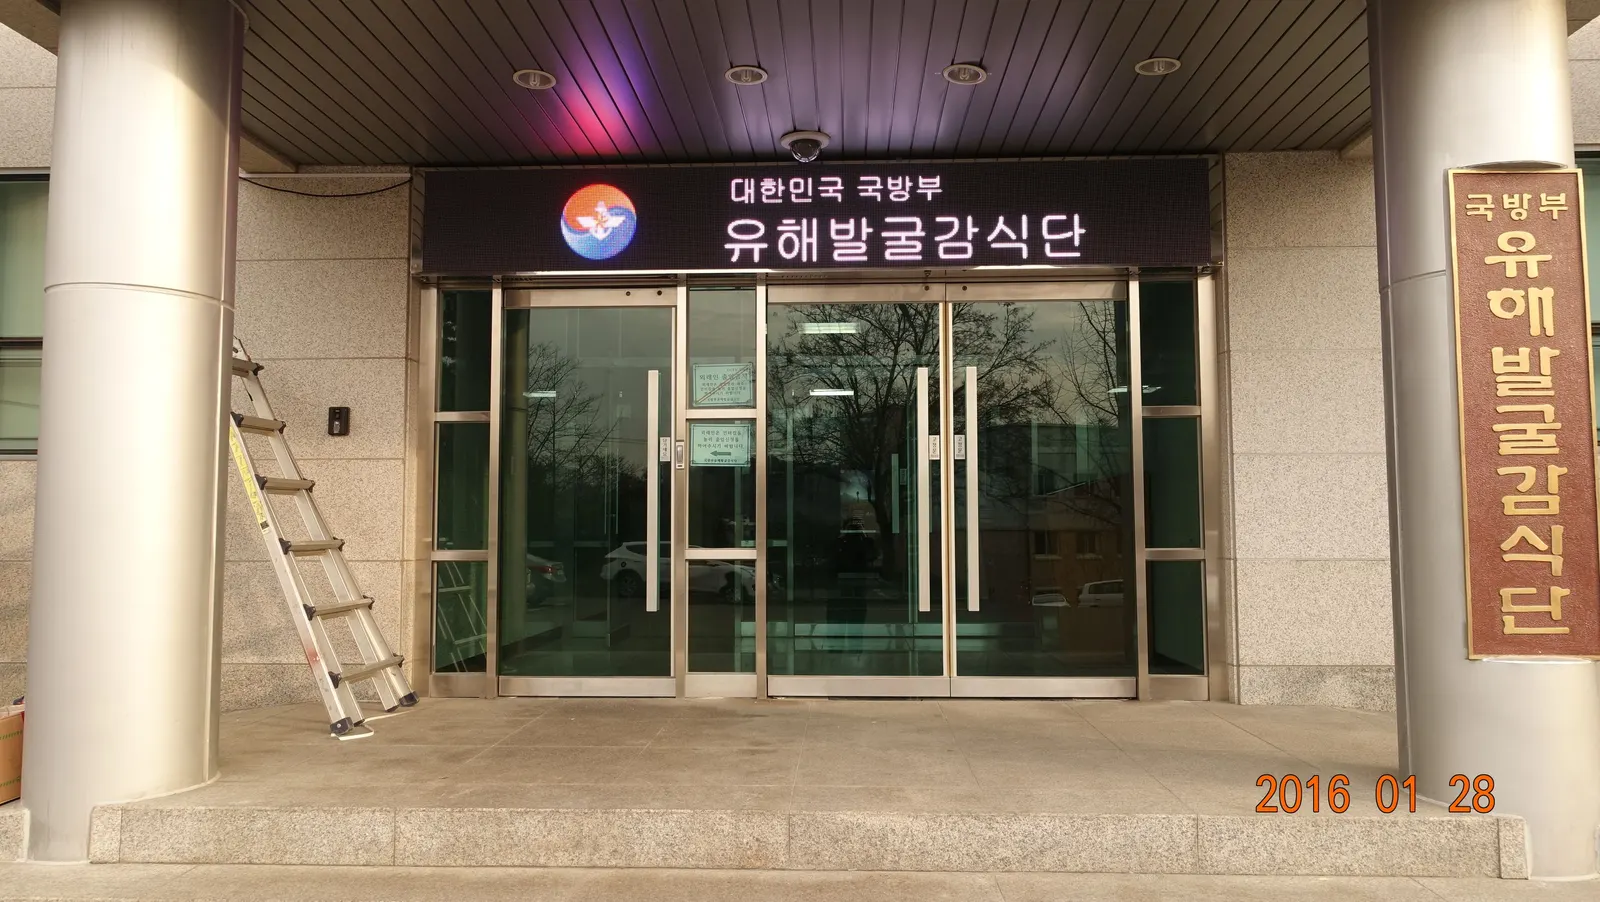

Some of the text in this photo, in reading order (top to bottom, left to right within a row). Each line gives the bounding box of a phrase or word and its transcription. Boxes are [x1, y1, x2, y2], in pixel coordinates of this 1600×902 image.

[731, 175, 943, 204] 대한민국 국방부
[1465, 193, 1569, 222] 국방부
[724, 214, 1086, 262] 유해발굴감식단
[1484, 230, 1571, 635] 유해발굴감식단
